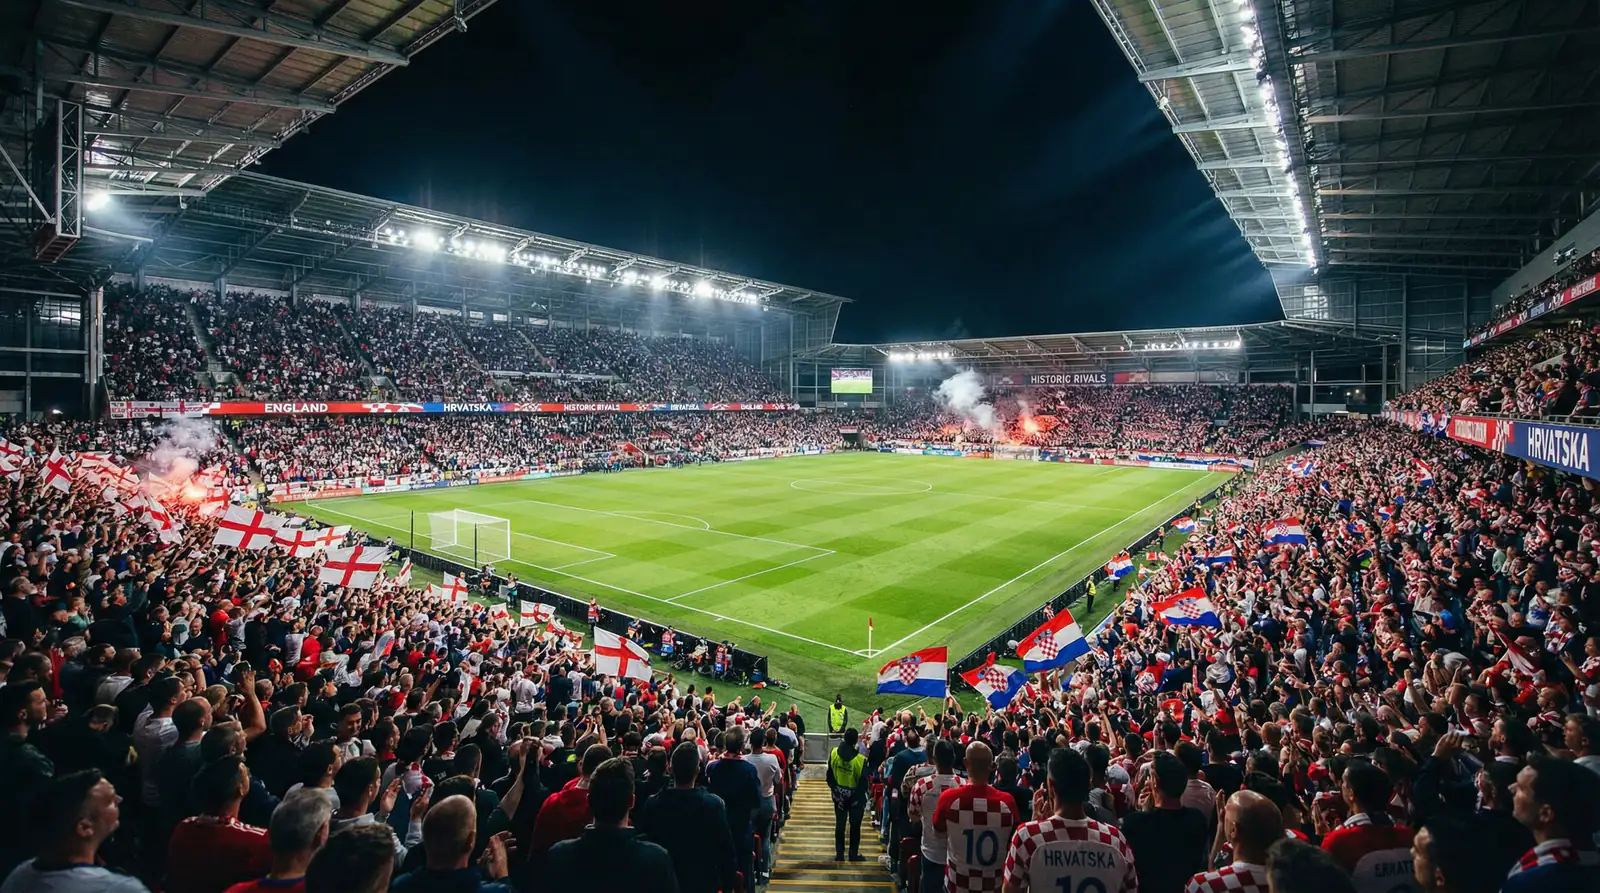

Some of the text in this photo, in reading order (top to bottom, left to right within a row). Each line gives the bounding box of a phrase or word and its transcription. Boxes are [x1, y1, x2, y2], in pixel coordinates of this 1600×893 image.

[1031, 374, 1107, 384] HISTORIC RIVALS
[264, 403, 329, 413] ENGLAND
[443, 403, 493, 412] HRVATSKA
[1528, 426, 1590, 472] HRVATSKA
[962, 828, 999, 867] 10
[1044, 848, 1116, 869] HRVATSKA
